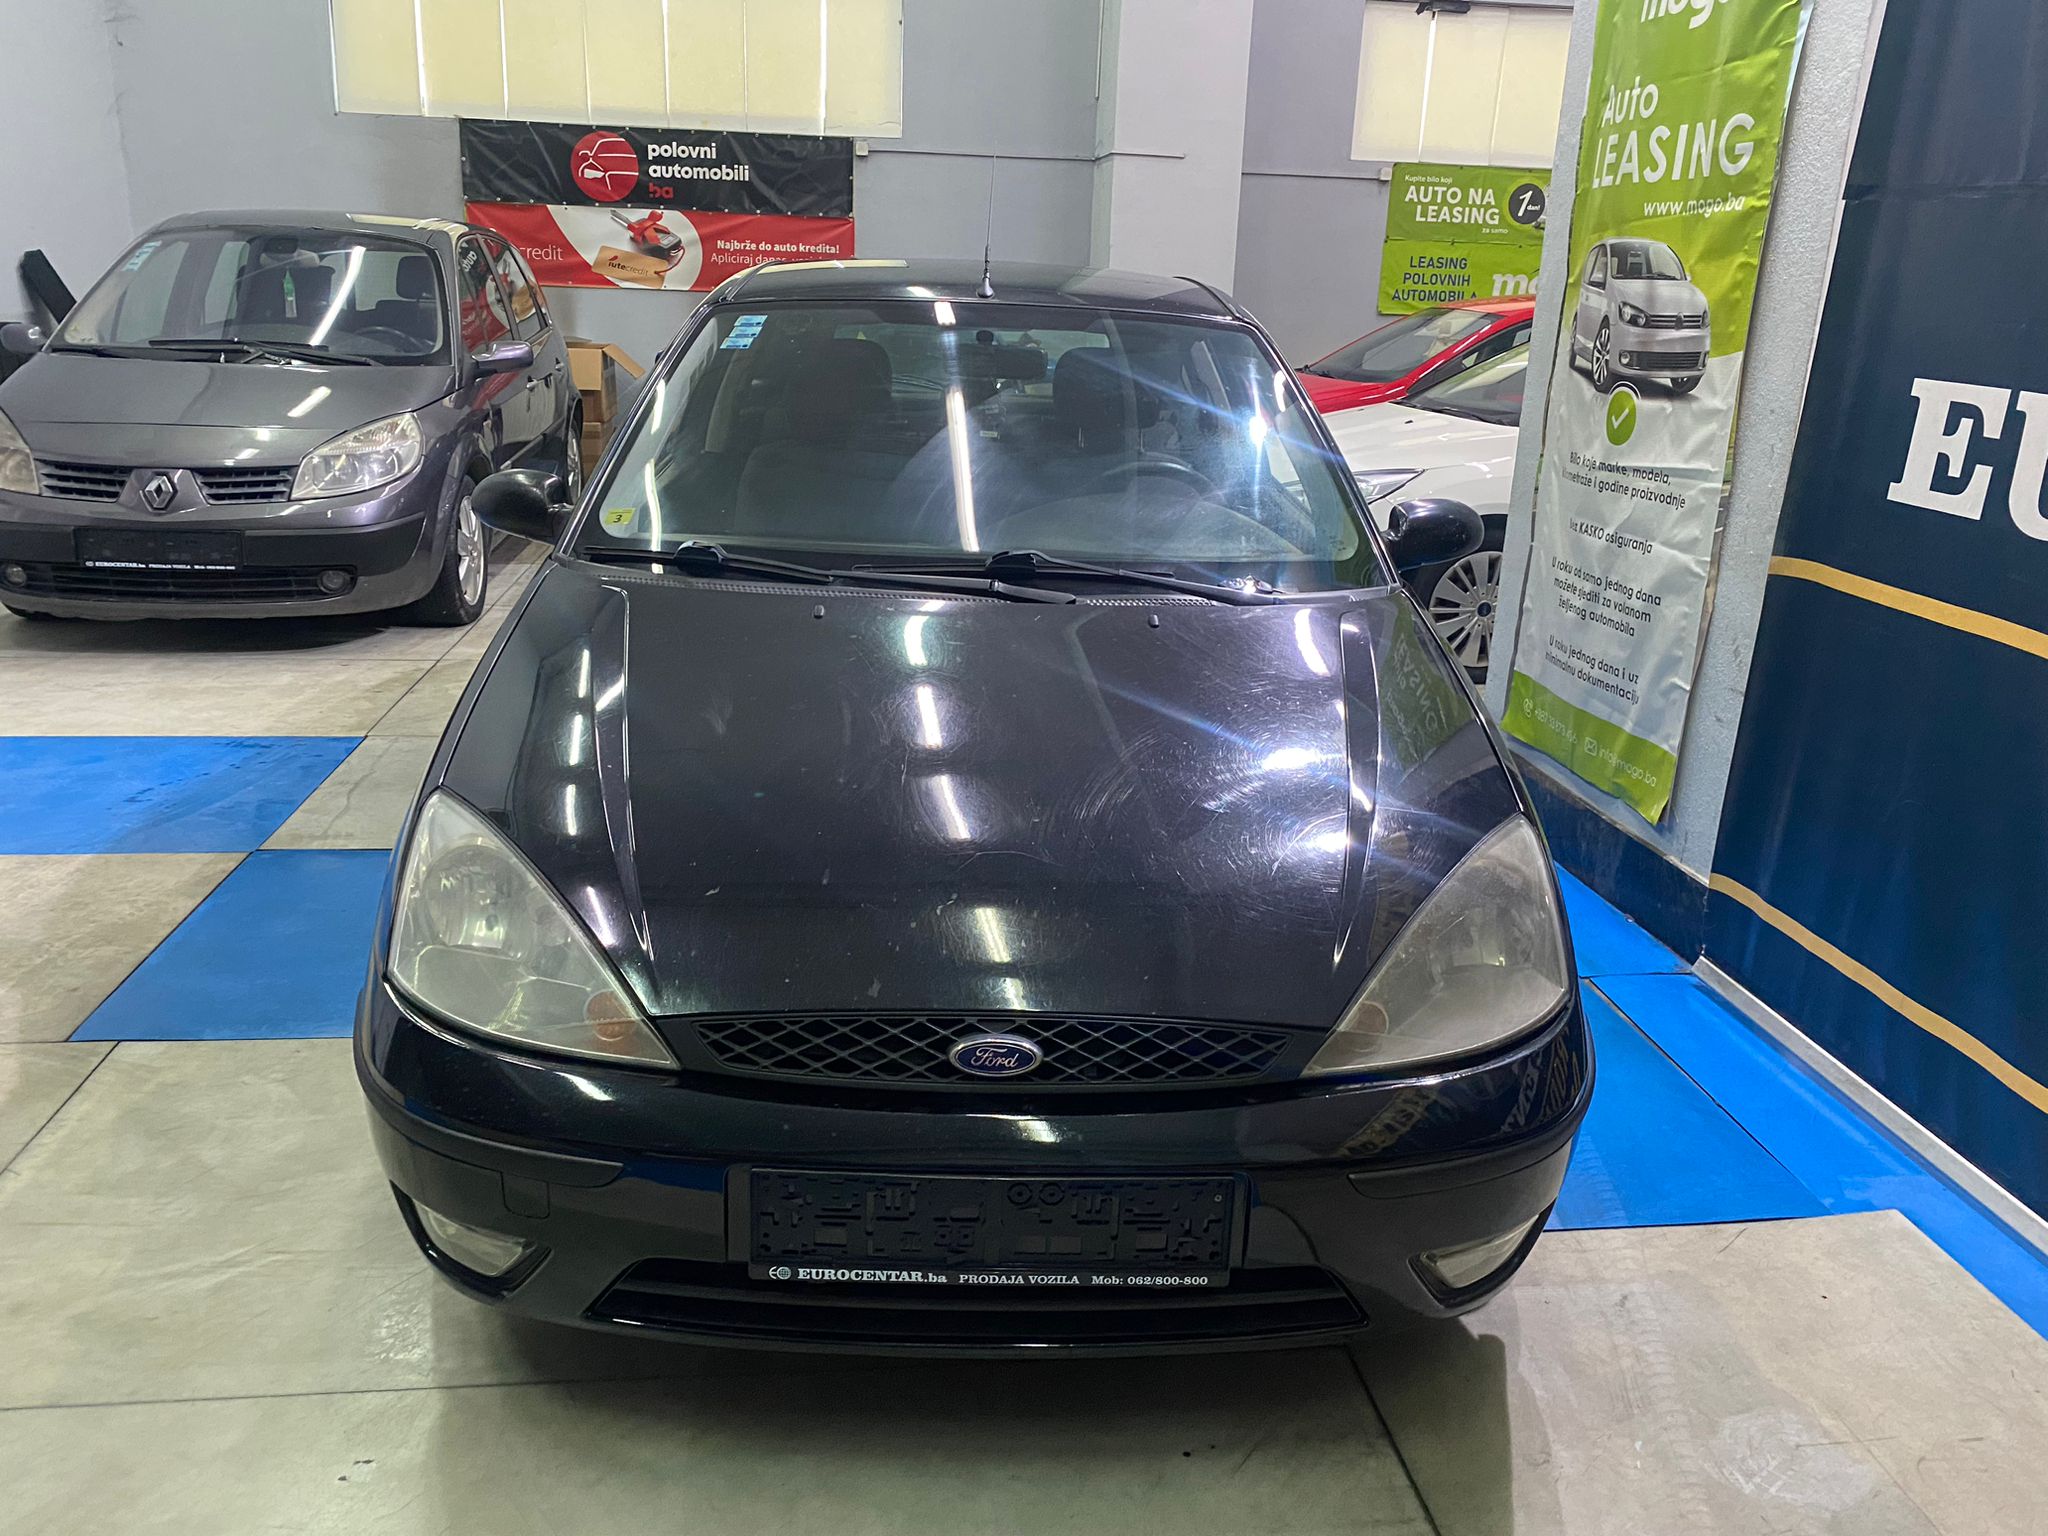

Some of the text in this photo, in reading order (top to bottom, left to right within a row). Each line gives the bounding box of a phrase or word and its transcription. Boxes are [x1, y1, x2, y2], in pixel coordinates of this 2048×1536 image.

[1601, 75, 1659, 128] Auto
[647, 142, 717, 162] polovni
[1592, 112, 1755, 189] LEASING
[648, 163, 749, 182] automobili
[1404, 174, 1453, 185] Kupite bilo koji
[1405, 185, 1495, 206] AUTO NA
[1517, 190, 1533, 217] 1
[1644, 192, 1747, 218] www.mogo.ba
[1416, 205, 1500, 225] LEASING
[710, 253, 753, 266] Apliciraj
[717, 240, 840, 254] Najbrže do auto kredita!
[1409, 256, 1468, 270] LEASING
[1403, 272, 1471, 287] POLOVNIH
[1582, 455, 1597, 472] koje
[1598, 461, 1630, 477] marke,
[1632, 468, 1672, 486] modela,
[1598, 480, 1629, 495] godine
[1630, 487, 1687, 511] proizvodnje
[613, 514, 623, 523] 3
[1578, 522, 1605, 541] KASKO
[1605, 531, 1653, 556] osiguranja
[1552, 556, 1662, 606] U roku od samo jednog dana
[1553, 576, 1652, 623] možete sjediti za volanom
[1558, 595, 1635, 637] željenog automobila
[1549, 634, 1555, 647] U
[1568, 644, 1596, 670] jednog
[1597, 658, 1621, 680] dana
[1622, 666, 1627, 680] i
[1628, 672, 1640, 686] uz
[1577, 667, 1640, 706] dokumentaciju
[1599, 746, 1658, 787] info@mogo.ba
[971, 1047, 1019, 1068] Ford
[797, 1268, 1208, 1286] EUROCENTAR.ba PRODAJA VOZILA Mob: 062/800-800
